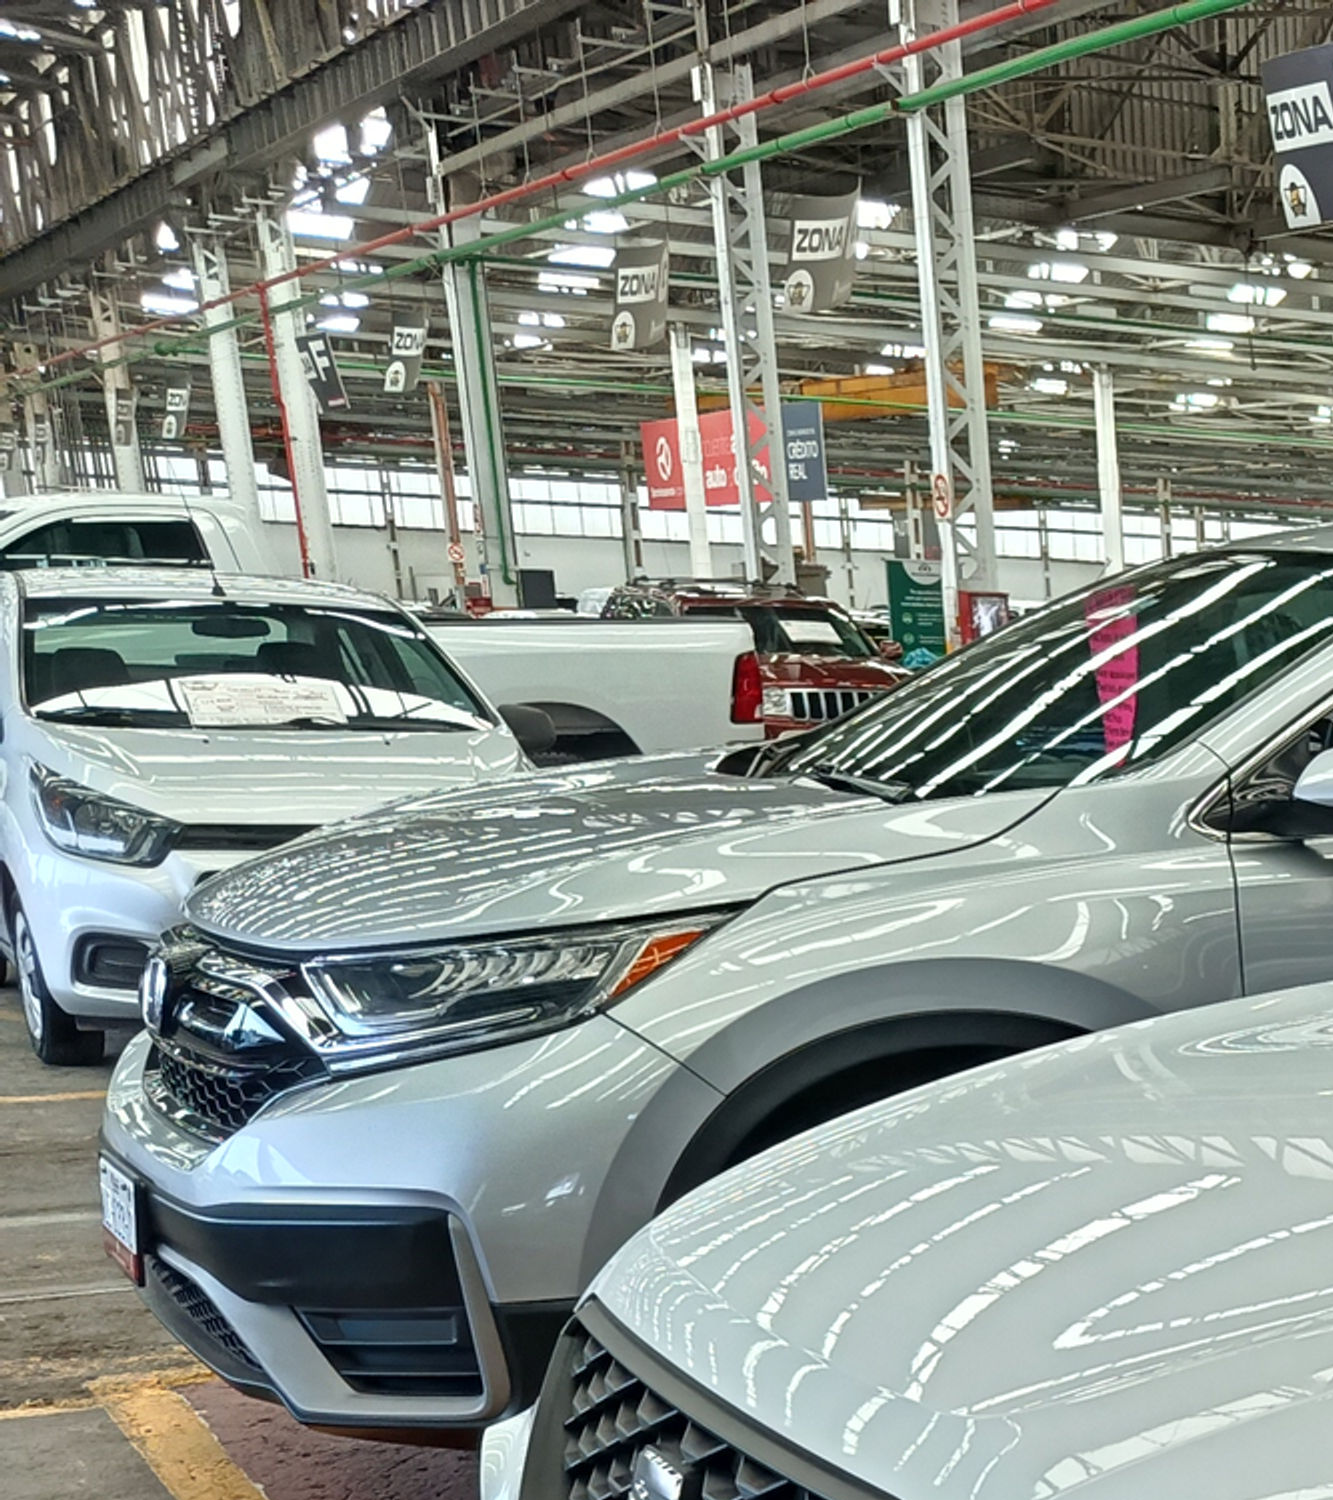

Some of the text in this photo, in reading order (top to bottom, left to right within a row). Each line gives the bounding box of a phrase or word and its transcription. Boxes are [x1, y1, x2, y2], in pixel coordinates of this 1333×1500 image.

[1270, 95, 1333, 141] ZONA
[796, 225, 844, 253] ZONA
[308, 340, 330, 381] F
